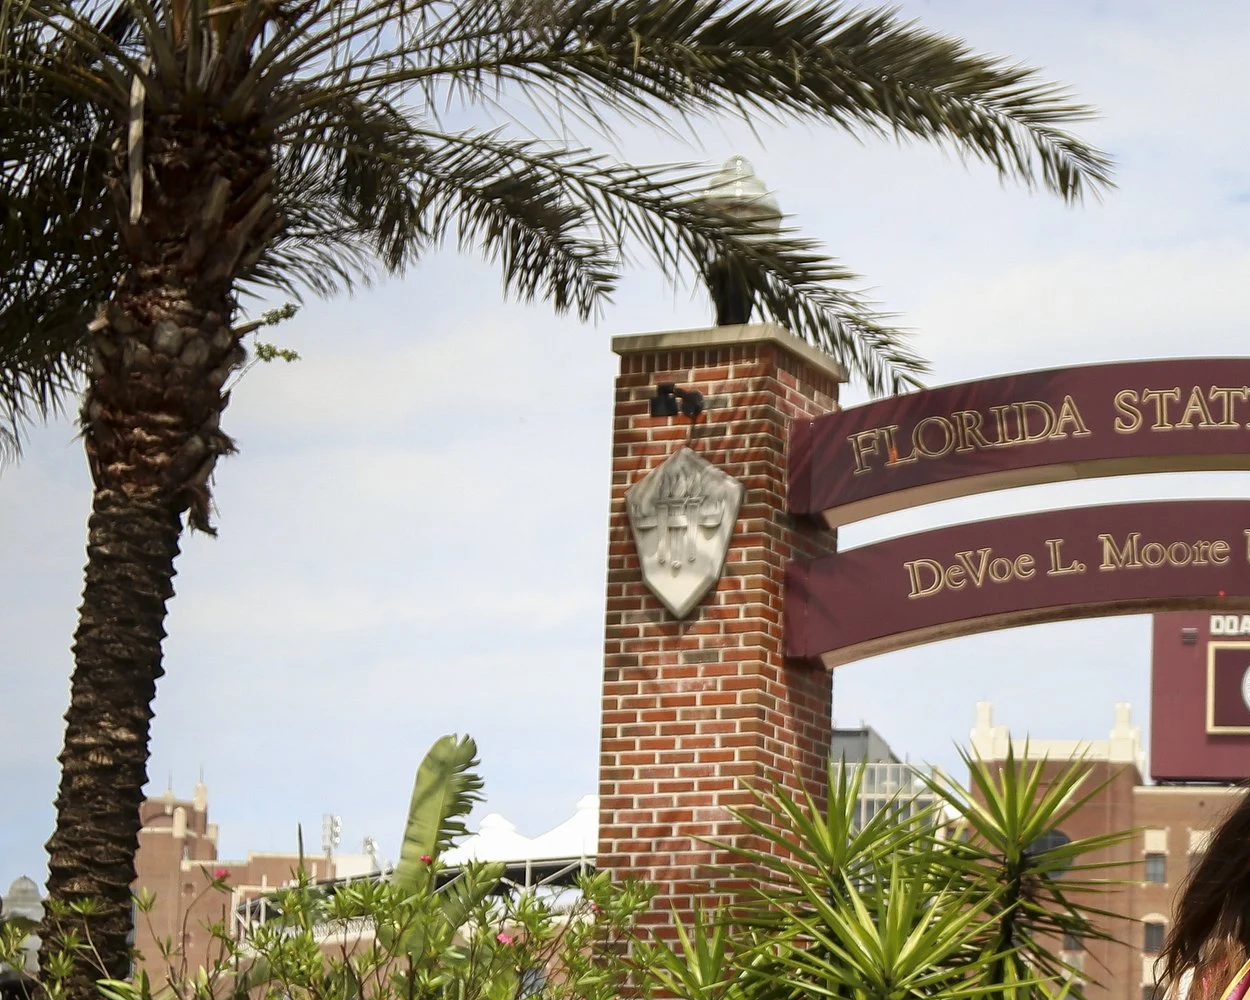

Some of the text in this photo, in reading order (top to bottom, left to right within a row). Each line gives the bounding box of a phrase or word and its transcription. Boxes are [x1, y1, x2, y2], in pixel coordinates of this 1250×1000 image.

[847, 395, 1090, 474] FLORIDA
[904, 548, 1035, 599] DeVoe
[1046, 538, 1087, 574] L.
[1098, 532, 1231, 570] Moore
